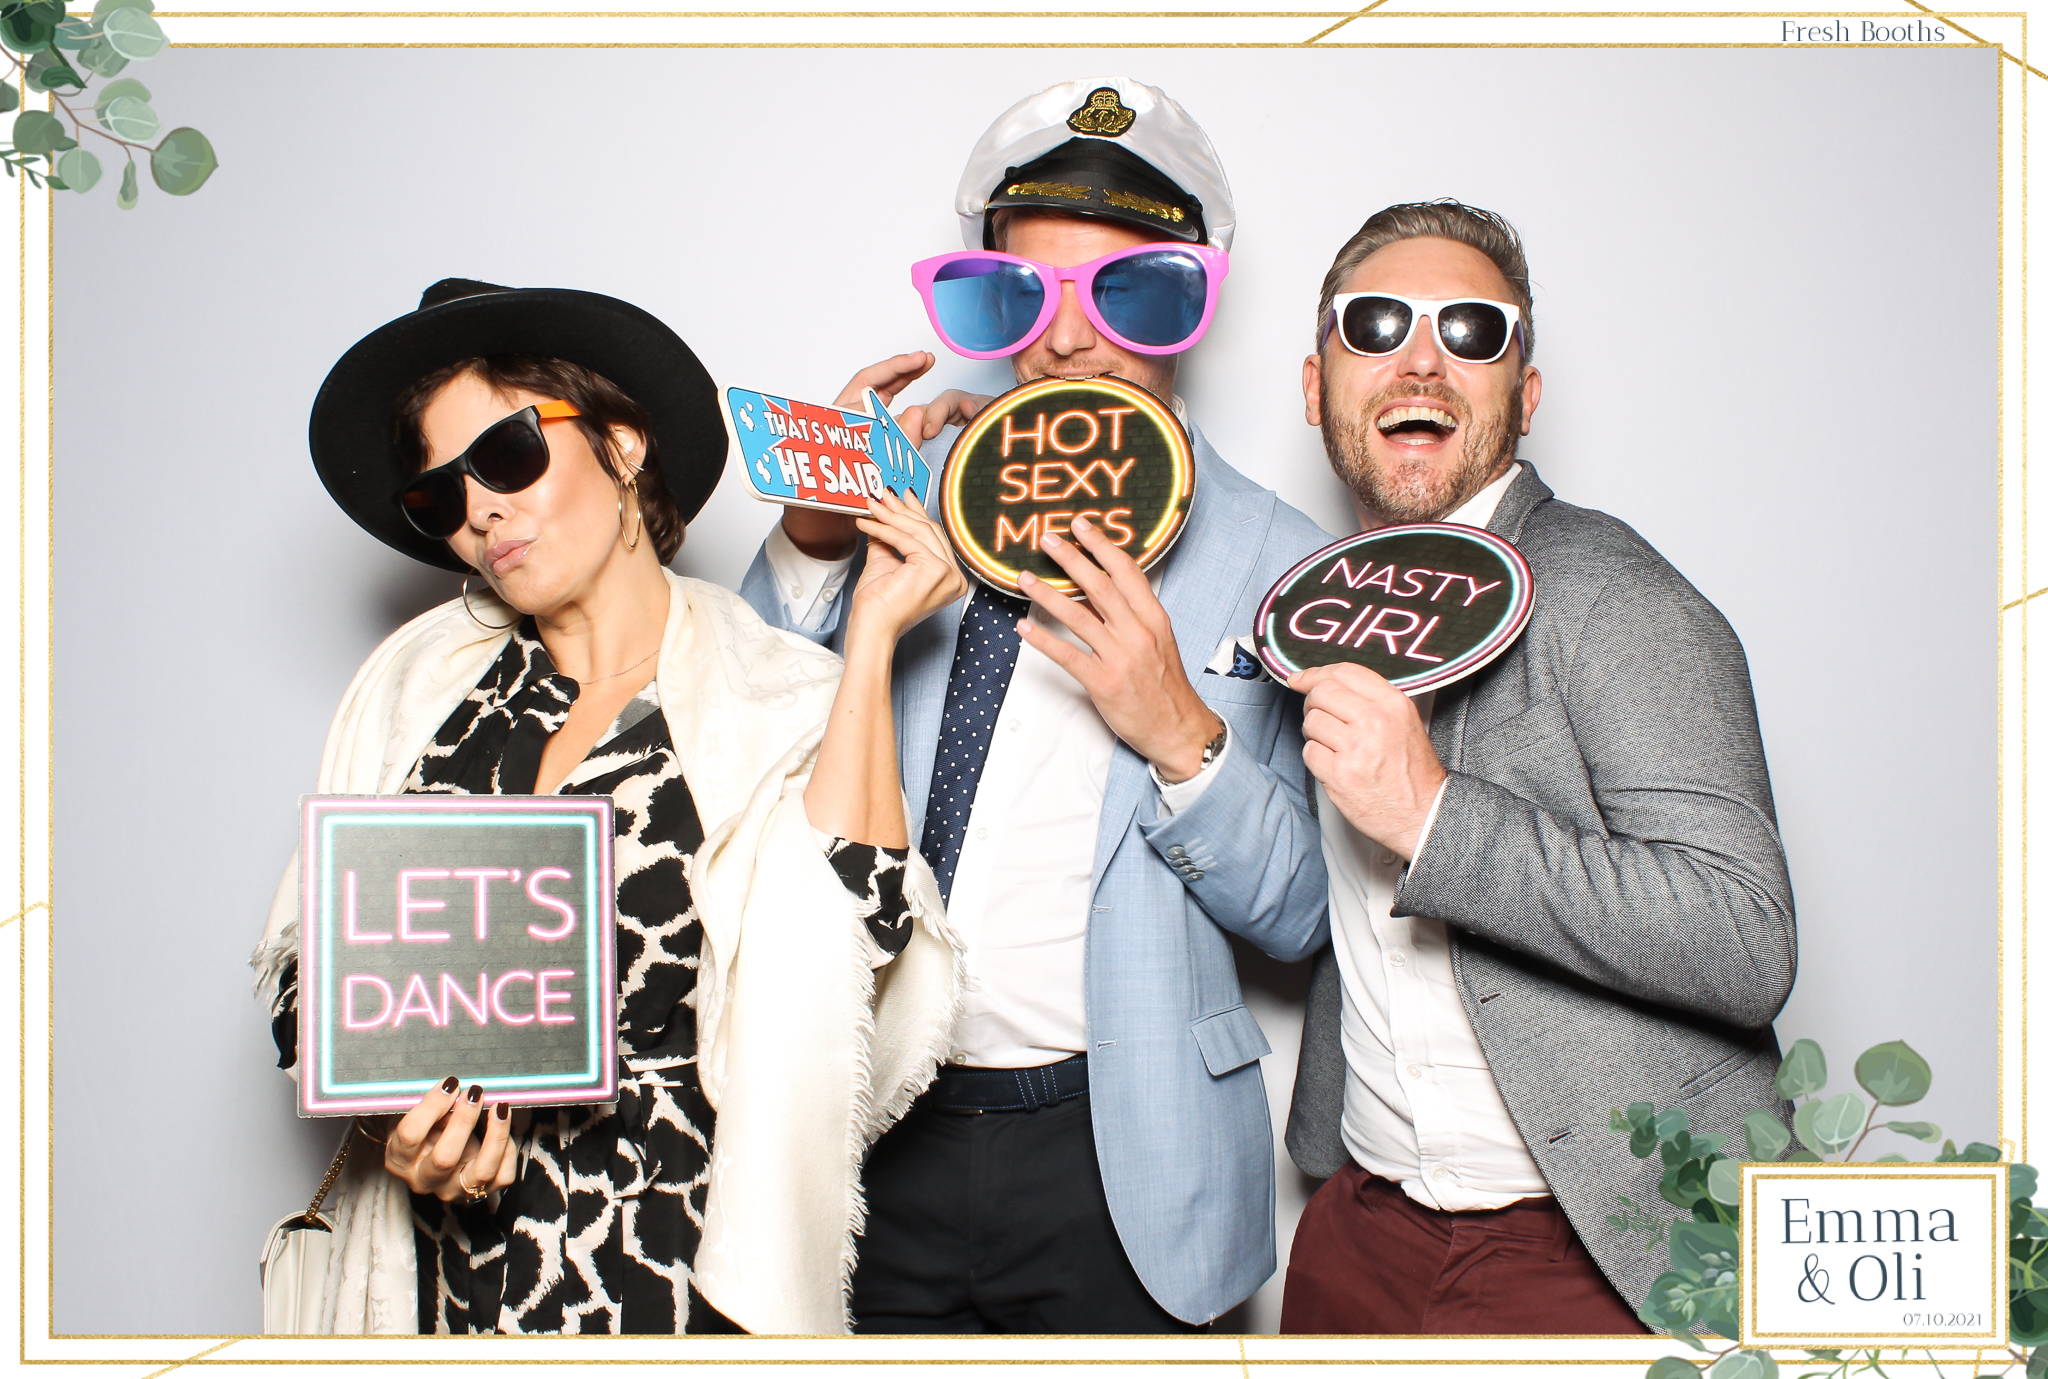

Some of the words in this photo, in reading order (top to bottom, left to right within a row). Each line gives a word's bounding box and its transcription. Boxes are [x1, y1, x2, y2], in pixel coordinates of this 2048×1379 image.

[763, 410, 824, 445] THAT'S
[824, 423, 873, 454] WHAT
[1003, 407, 1137, 458] HOT
[774, 447, 818, 490] HE
[818, 454, 885, 501] SAID
[999, 458, 1135, 503] SEXY
[1321, 557, 1502, 607] NASTY
[1288, 598, 1444, 663] GIRL
[344, 868, 576, 943] LET'S
[343, 970, 576, 1029] DANCE
